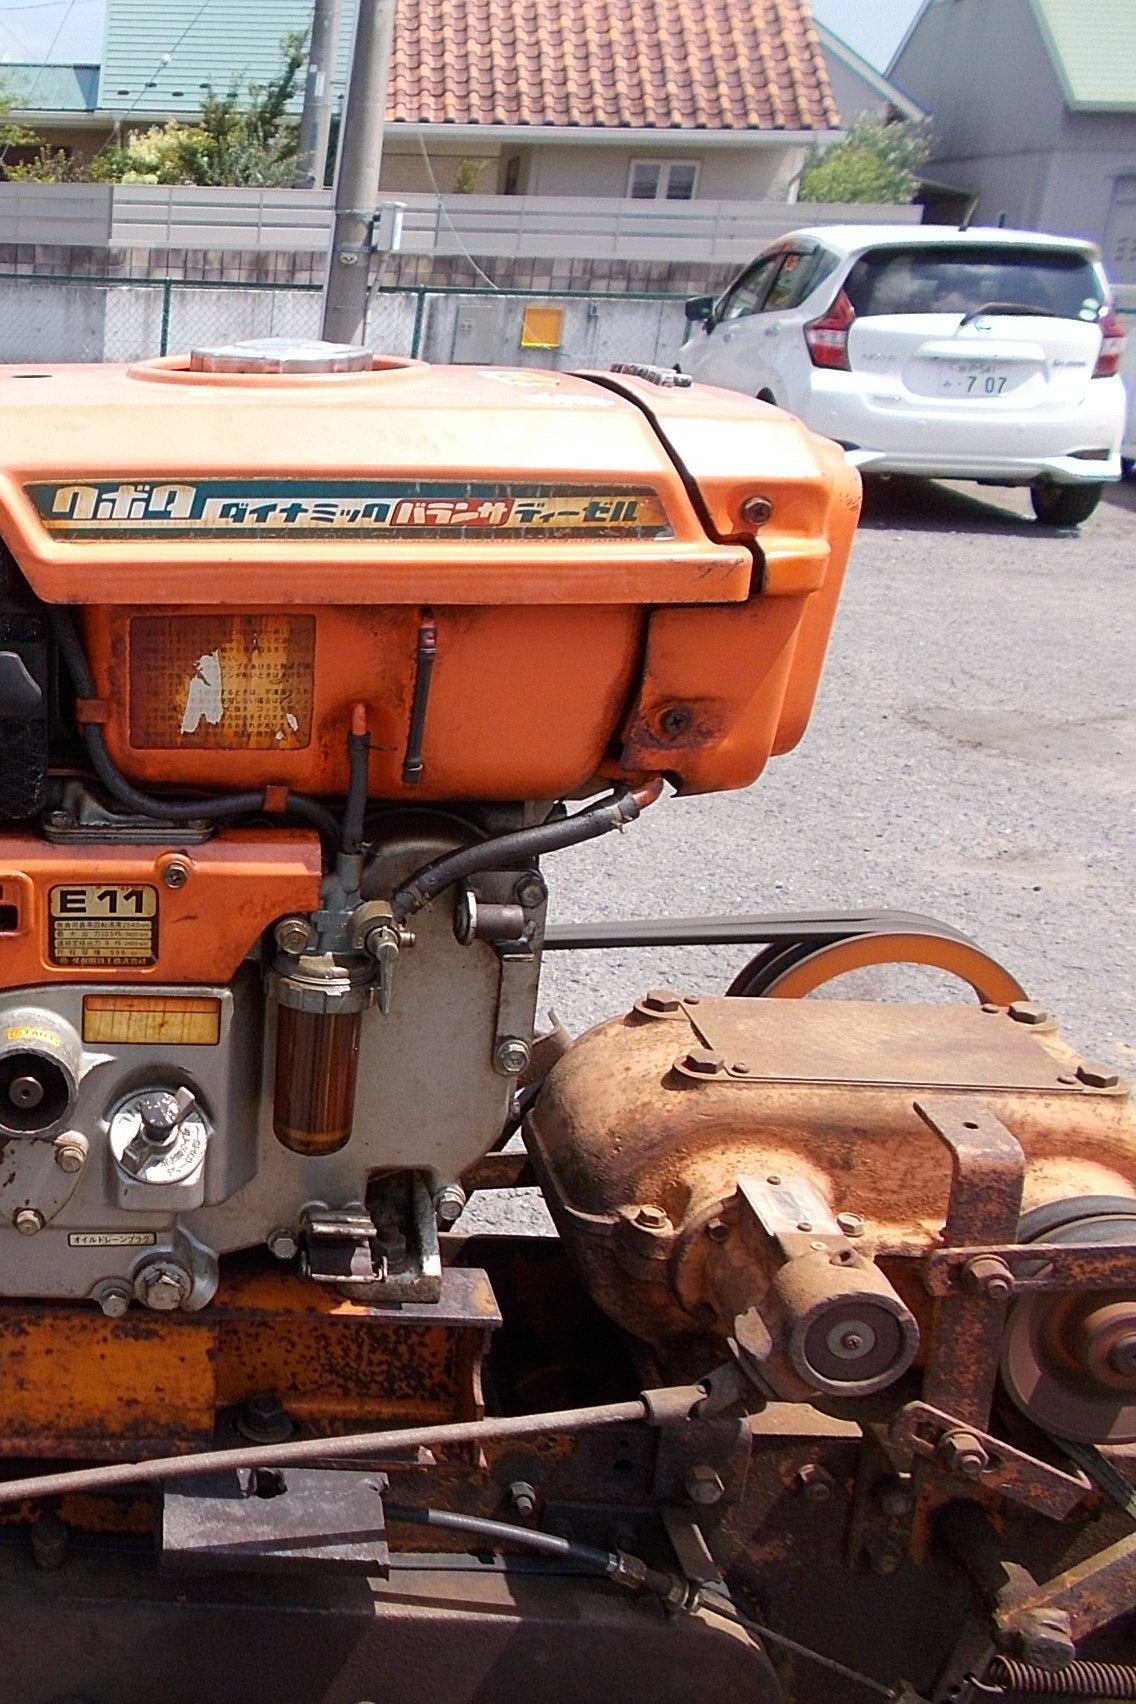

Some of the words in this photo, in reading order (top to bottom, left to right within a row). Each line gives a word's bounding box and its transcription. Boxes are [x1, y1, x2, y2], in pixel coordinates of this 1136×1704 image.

[51, 484, 197, 520] クボタ
[73, 1235, 151, 1245] オイルドレーンプラグ
